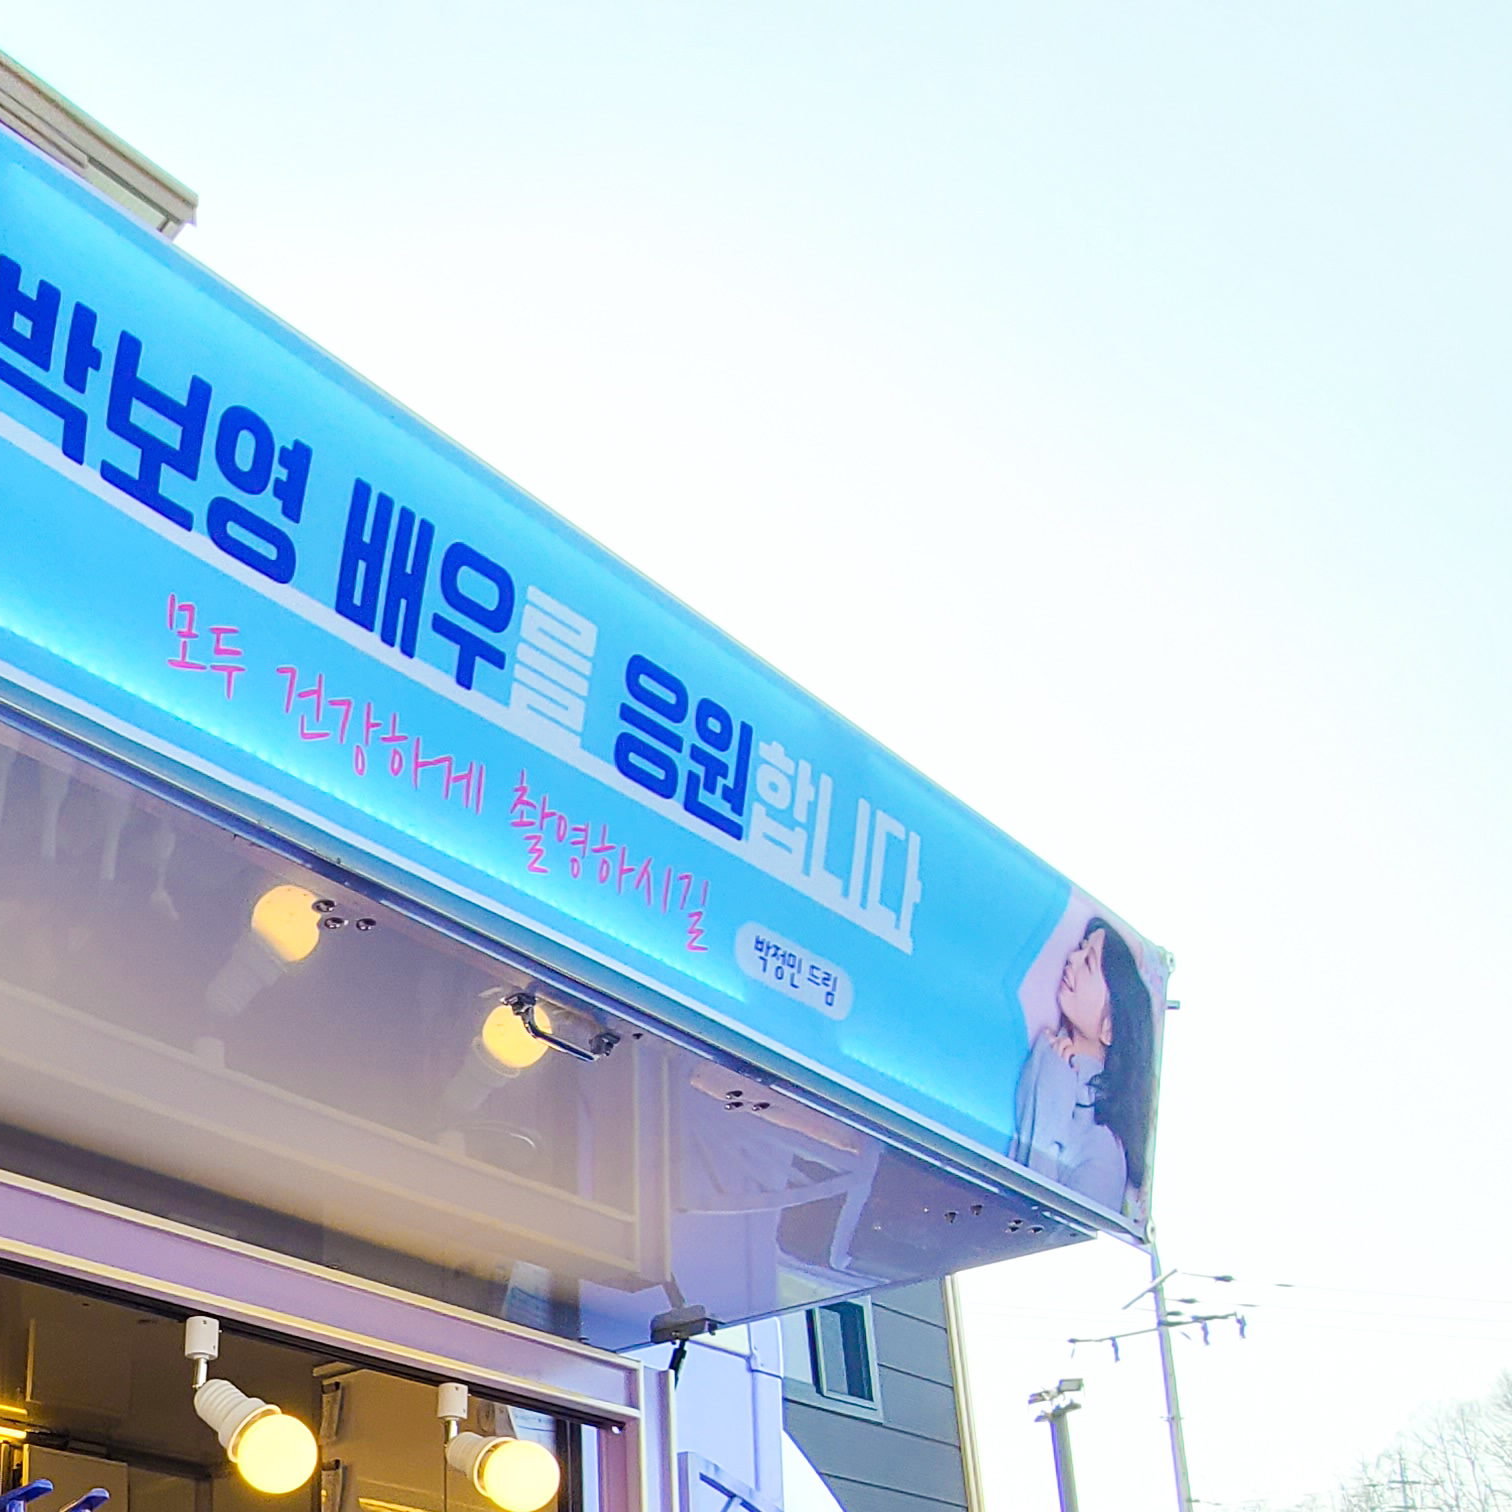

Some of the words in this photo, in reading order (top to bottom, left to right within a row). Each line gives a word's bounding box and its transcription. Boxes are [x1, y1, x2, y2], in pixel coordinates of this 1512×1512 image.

[167, 593, 246, 700] 모두
[276, 666, 485, 815] 건강하게
[510, 768, 709, 952] 촬영하시길
[334, 477, 598, 748] 배우를
[612, 652, 924, 938] 응원합니다
[754, 935, 803, 989] 박정민
[806, 964, 838, 1007] 드림
